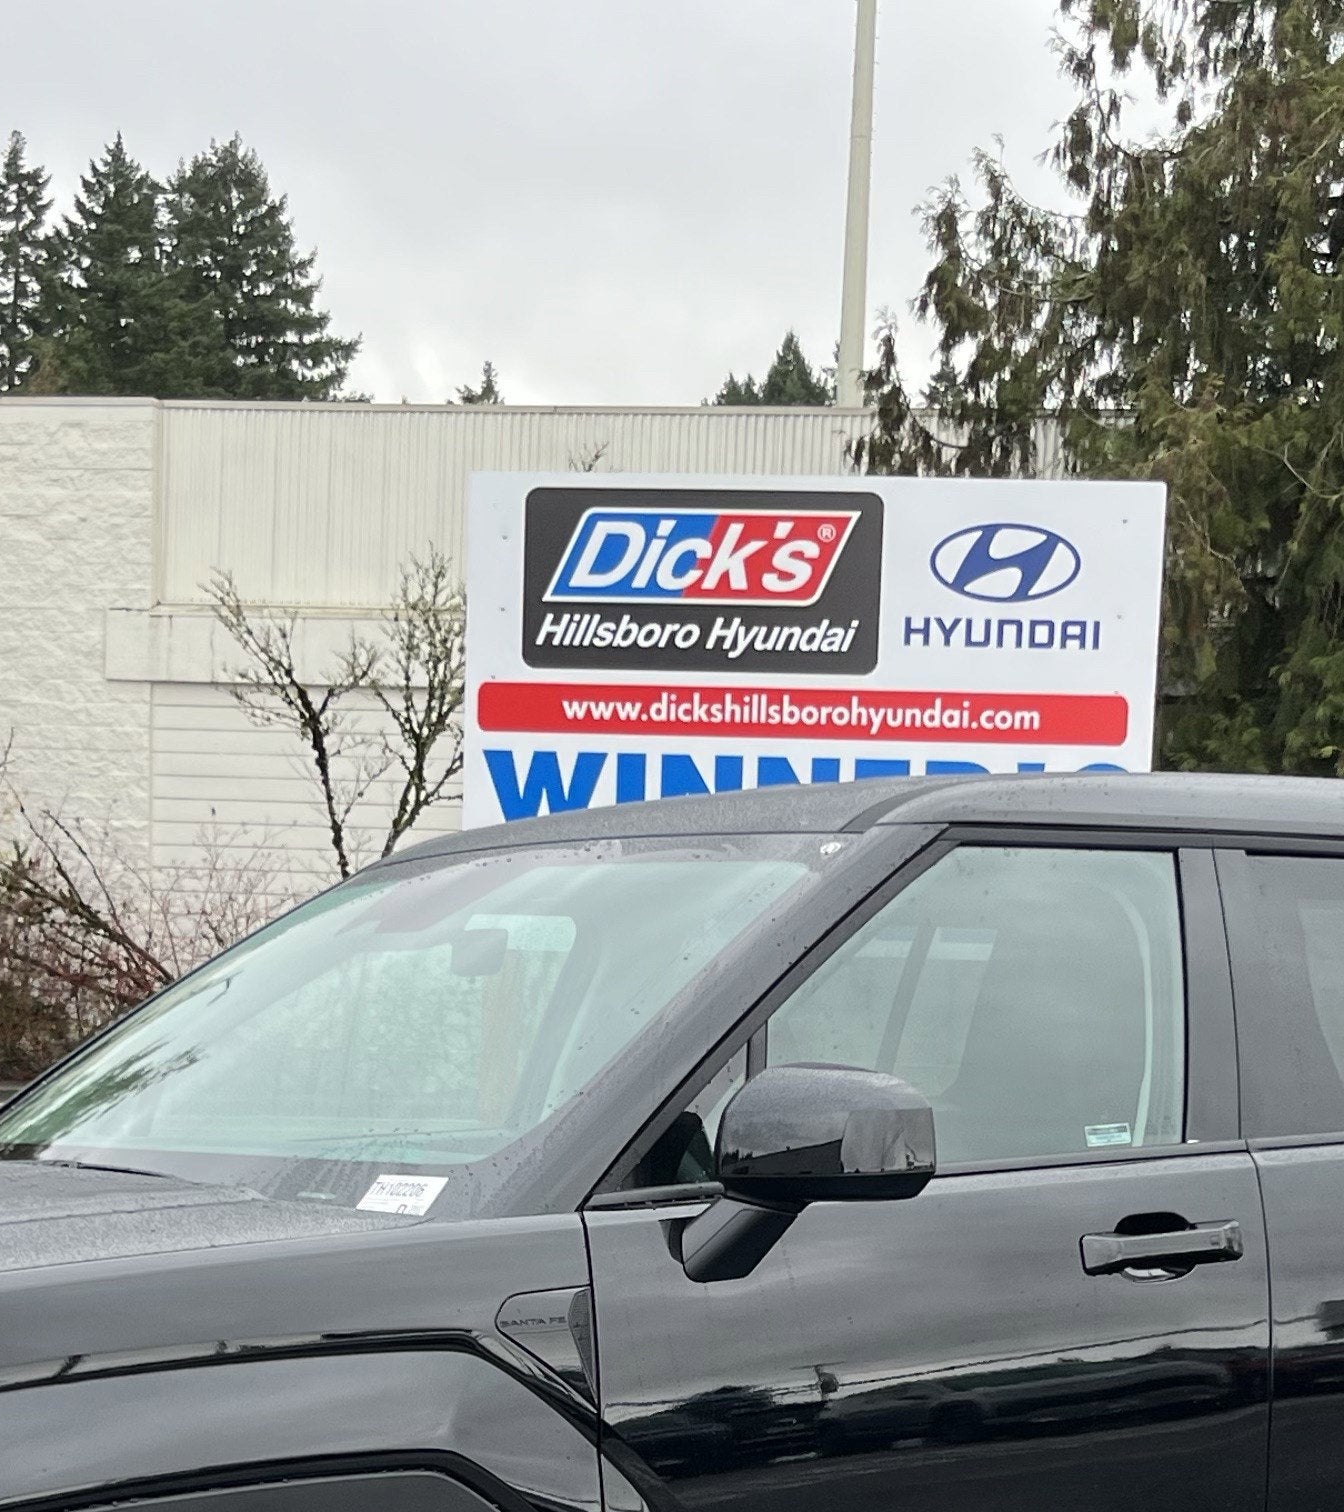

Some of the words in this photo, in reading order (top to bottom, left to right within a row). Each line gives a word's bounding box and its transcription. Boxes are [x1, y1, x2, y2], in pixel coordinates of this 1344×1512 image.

[534, 612, 699, 650] Hillsboro
[706, 615, 860, 659] Hyundai
[903, 616, 1101, 651] HYUNDAI
[562, 694, 1041, 735] www.dickshillsborohyundai.com
[499, 1317, 547, 1328] SANTA
[548, 1316, 568, 1325] FE
